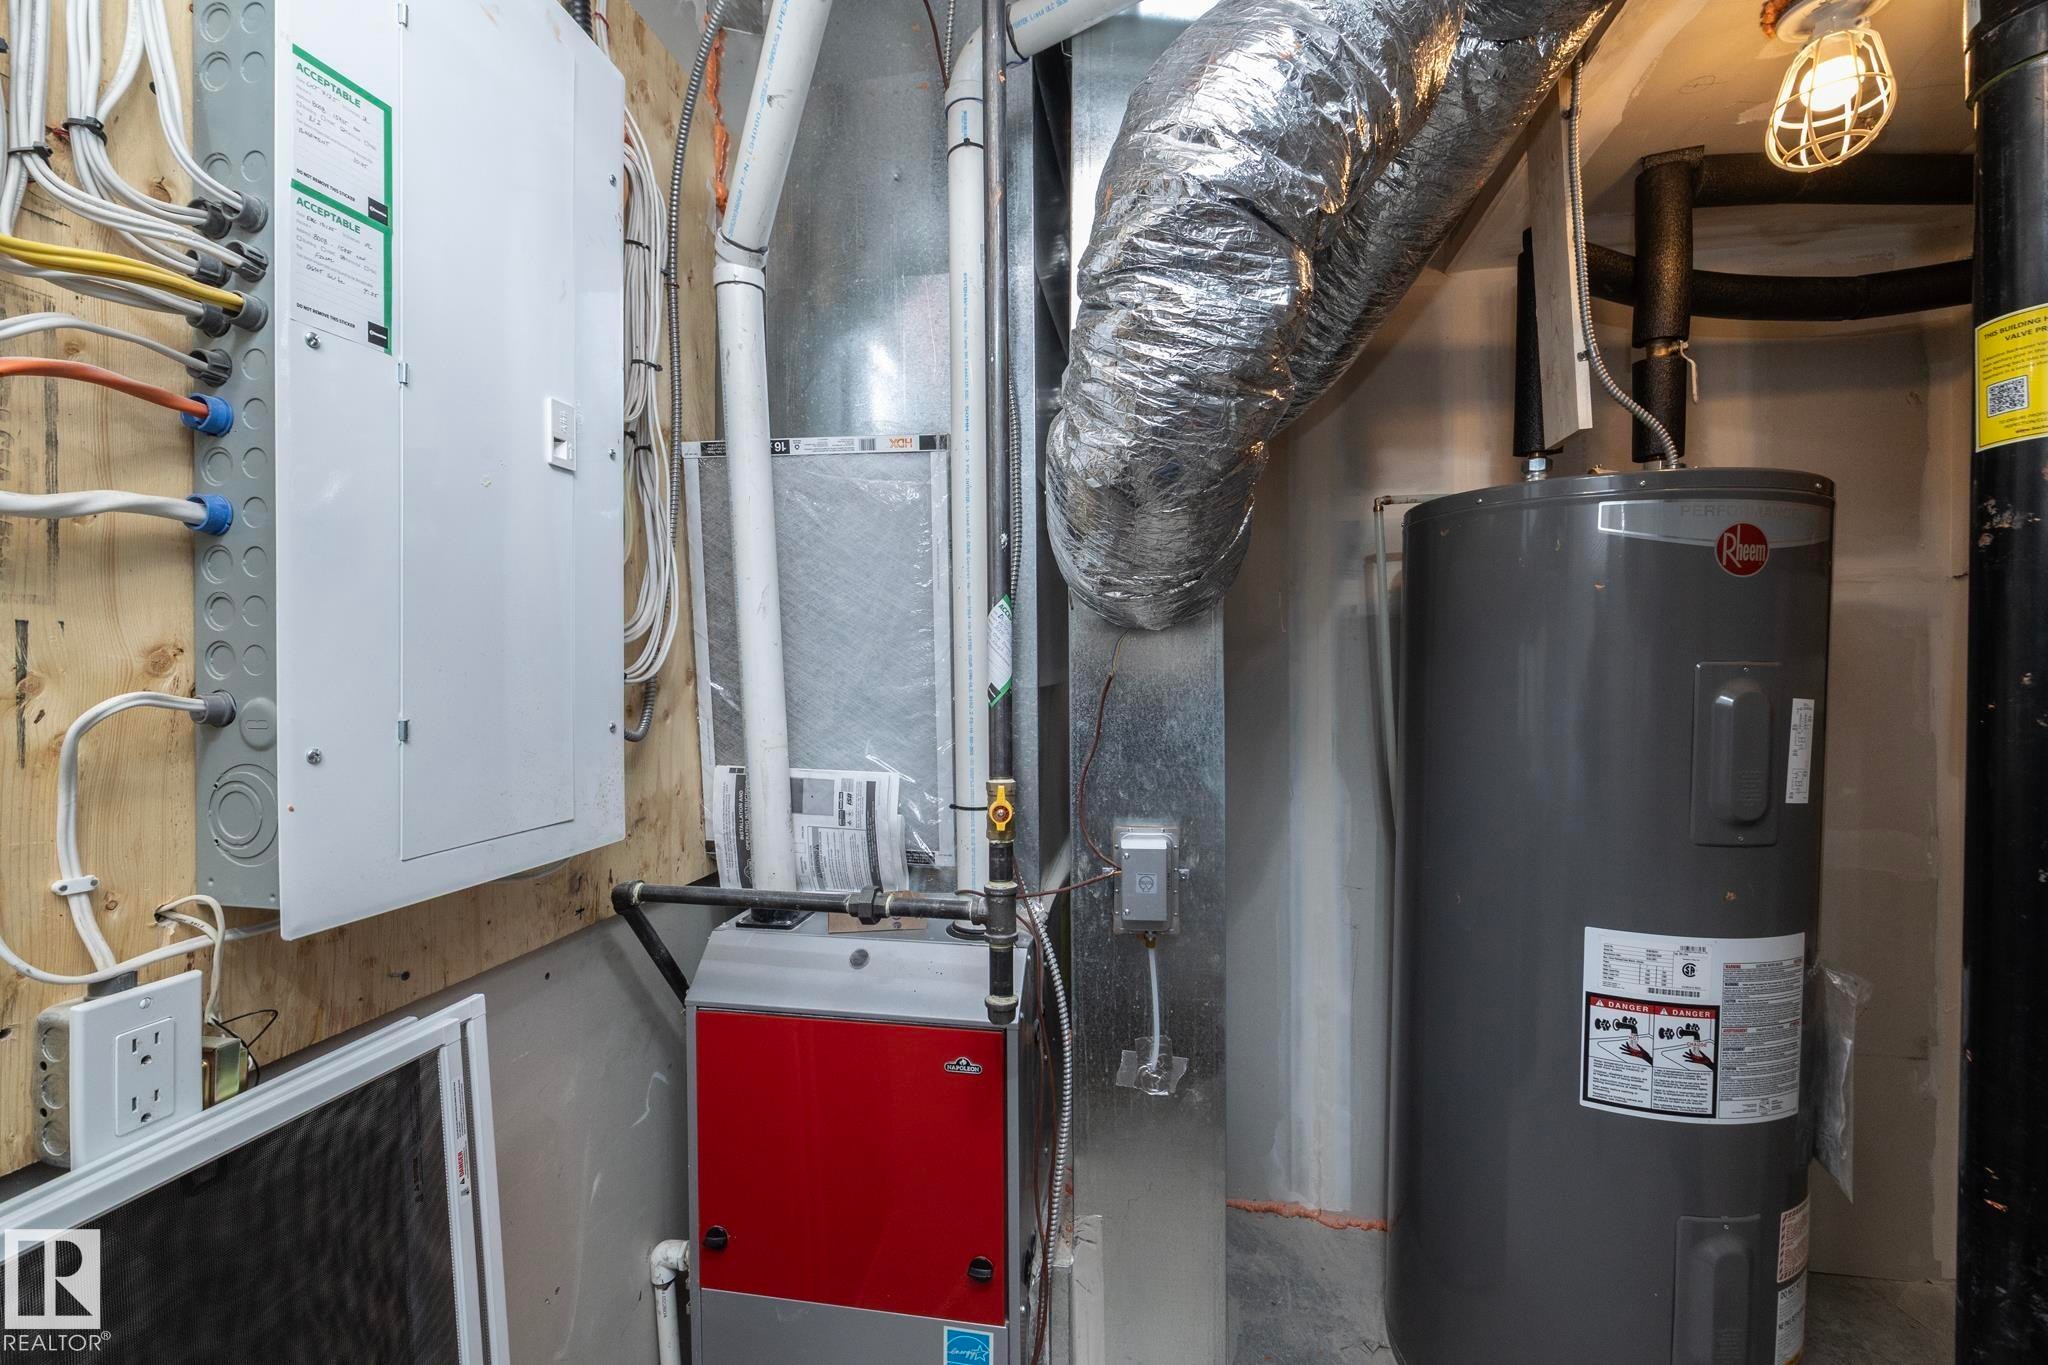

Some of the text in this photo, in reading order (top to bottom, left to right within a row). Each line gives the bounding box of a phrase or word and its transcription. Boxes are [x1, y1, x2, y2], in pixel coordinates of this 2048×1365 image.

[296, 62, 361, 109] ACCEPTABLE
[296, 168, 355, 202] DO NOT REMOVE THIS STICKER
[296, 196, 361, 234] ACCEPTABLE
[303, 305, 312, 313] NOT
[312, 309, 329, 319] REMOVE
[330, 314, 339, 323] THIS
[339, 318, 355, 328] STICKER
[1984, 330, 1999, 341] THIS
[1999, 317, 2041, 334] BUILDING
[2005, 328, 2033, 341] VALVE
[774, 442, 787, 452] 16
[889, 438, 912, 449] HDX
[1722, 524, 1766, 568] Rheem
[1608, 1001, 1649, 1013] DANGER
[1672, 1009, 1711, 1018] DANGER
[946, 1064, 980, 1073] NAPOLEON
